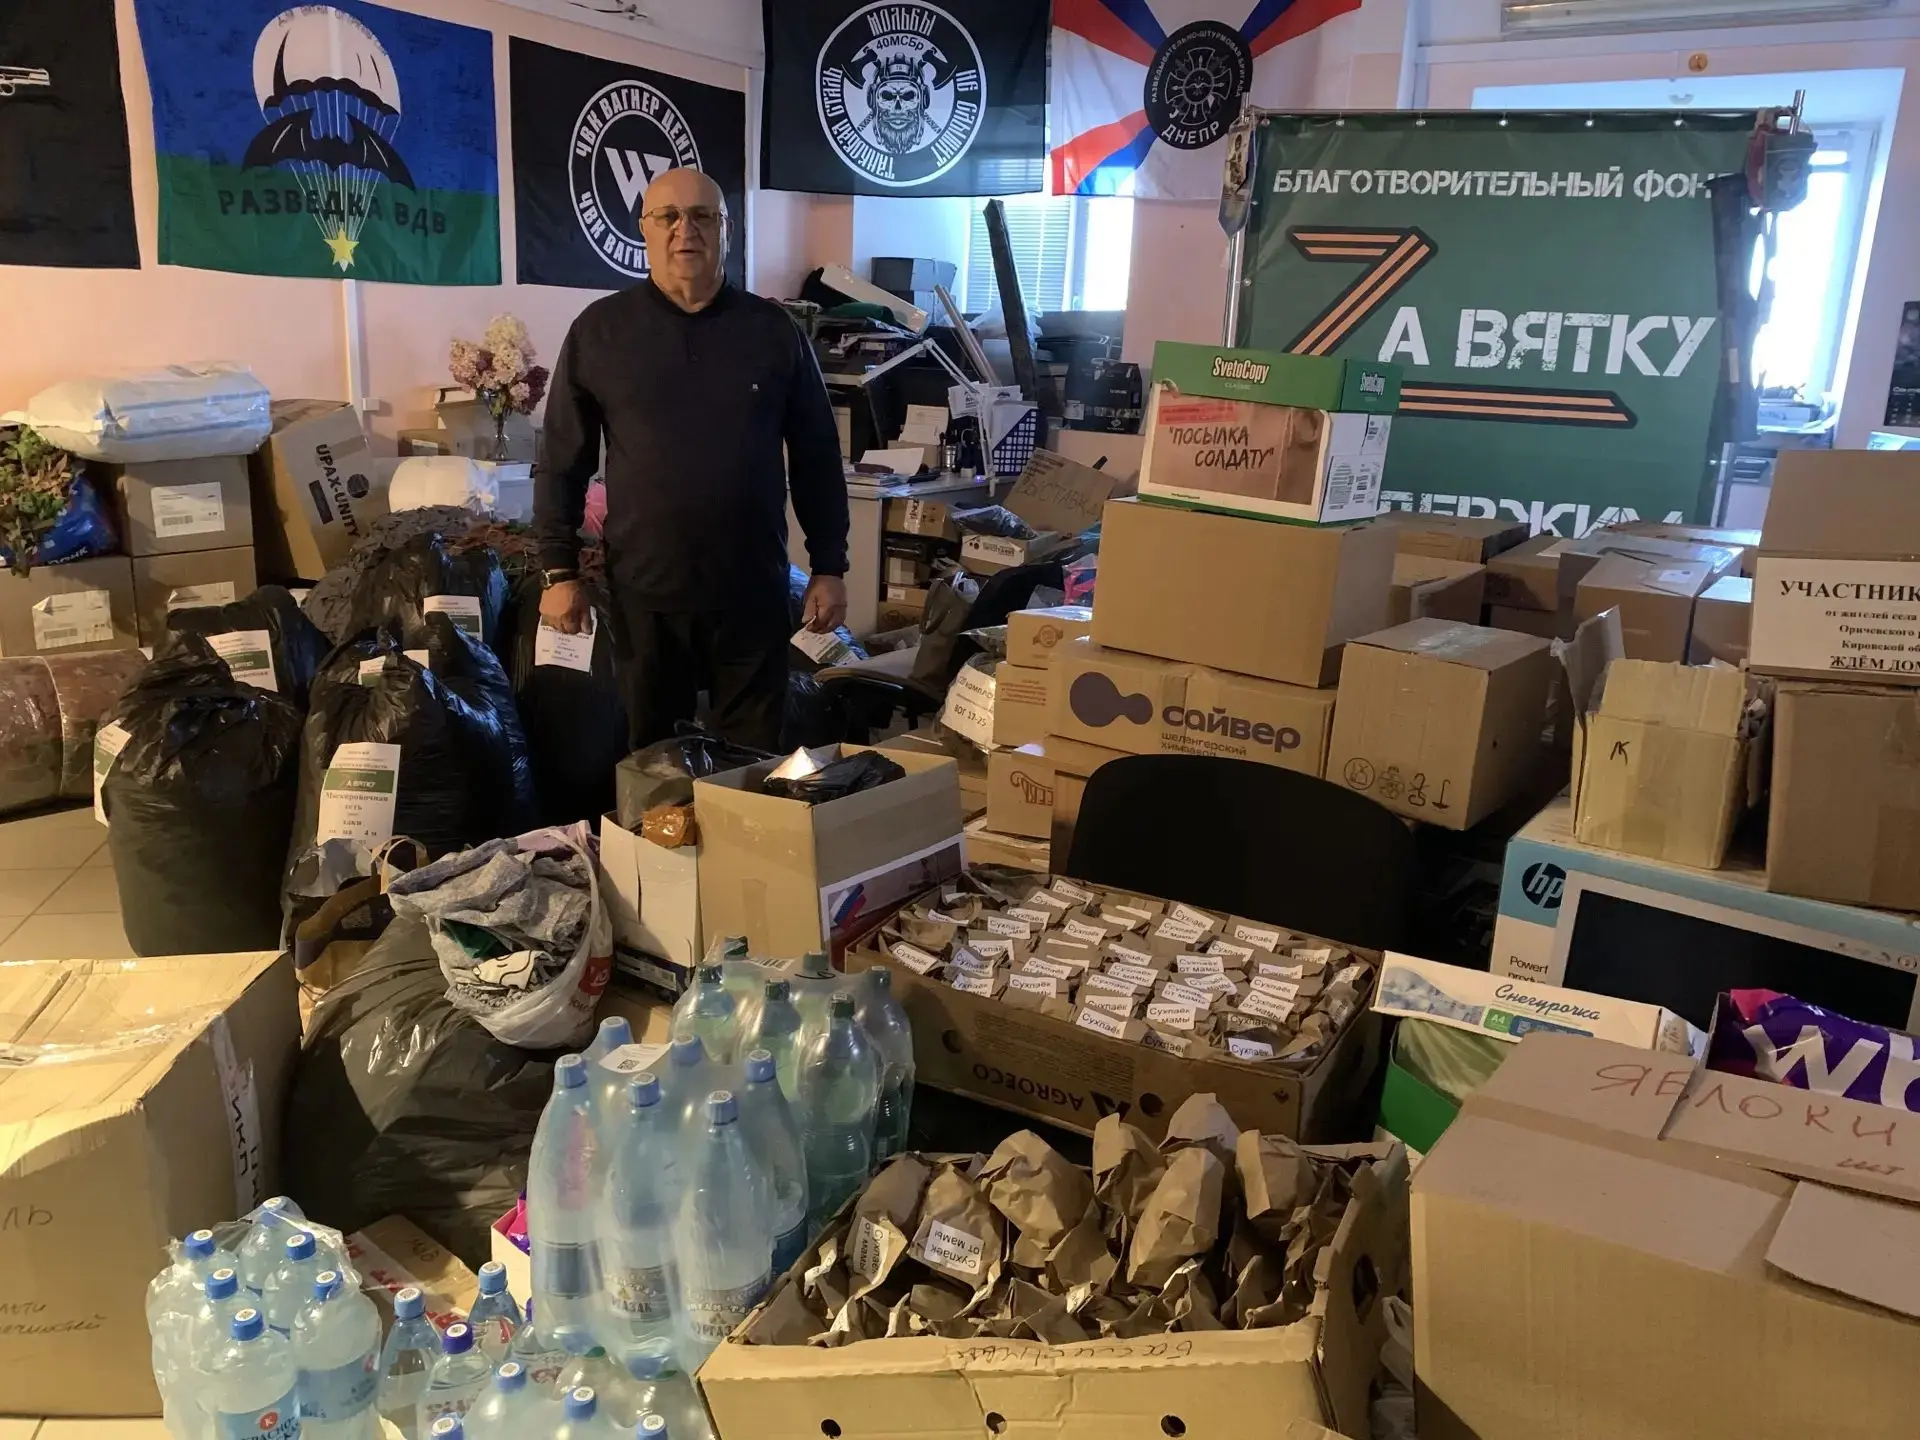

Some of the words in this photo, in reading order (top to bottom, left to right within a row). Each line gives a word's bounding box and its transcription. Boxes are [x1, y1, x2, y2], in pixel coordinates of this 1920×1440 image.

[876, 35, 925, 51] 40МСБр
[575, 110, 604, 158] ЧВК
[599, 88, 660, 119] ВАГНЕР
[1160, 120, 1221, 145] ДНЕПР
[1272, 165, 1625, 199] БЛАГОТВОРИТЕЛЬНЫЙ
[1632, 168, 1730, 202] ФОН
[217, 188, 383, 222] РАЗВЕДКА
[394, 201, 448, 238] ВДВ
[578, 191, 605, 239] ЧВК
[1453, 308, 1717, 378] ВЯТКУ
[1211, 356, 1270, 385] SvetoCopy
[1169, 425, 1250, 447] "ПОСЫЛКА
[1194, 447, 1275, 471] СОЛДАТУ"
[315, 443, 361, 538] UPAX-UNITY
[1840, 609, 1889, 620] жителей
[1892, 612, 1917, 622] села
[1839, 624, 1915, 637] Оричевского
[1841, 639, 1905, 651] Кировской
[1829, 655, 1885, 670] ЖДЁМ
[1162, 705, 1301, 753] сайвер
[1526, 862, 1566, 909] hp
[1494, 983, 1601, 1022] Снегурочка
[1490, 1013, 1506, 1025] A4
[972, 1062, 1085, 1112] AGROECO
[934, 1229, 966, 1248] мамы
[965, 1243, 980, 1255] от
[931, 1244, 978, 1269] Сухпаек
